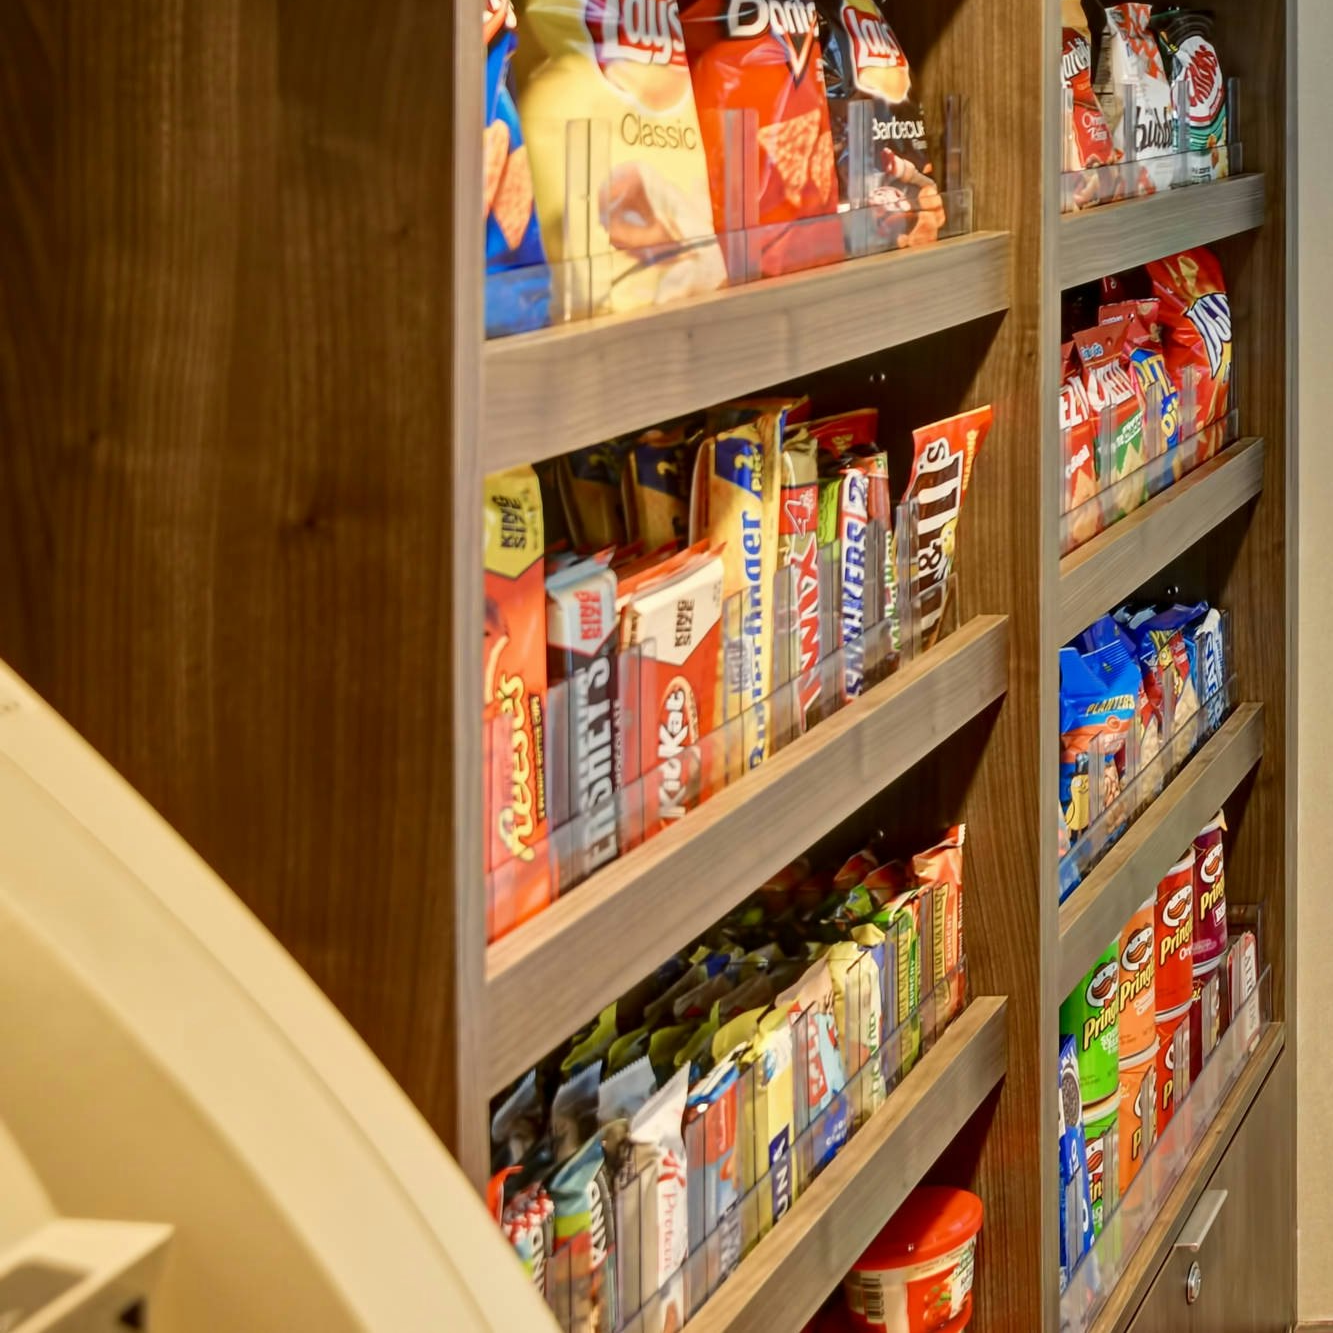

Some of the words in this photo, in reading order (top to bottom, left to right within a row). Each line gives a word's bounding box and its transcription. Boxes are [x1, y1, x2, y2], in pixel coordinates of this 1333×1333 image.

[621, 113, 697, 150] Classic
[674, 599, 685, 648] KING
[681, 599, 695, 647] SIZE
[1085, 693, 1136, 718] PLANTERS
[577, 655, 619, 871] ERSHEY'S
[1160, 914, 1193, 966] Pring
[1119, 958, 1154, 1012] Pring
[1082, 996, 1119, 1052] Pring
[771, 1138, 790, 1219] UNA
